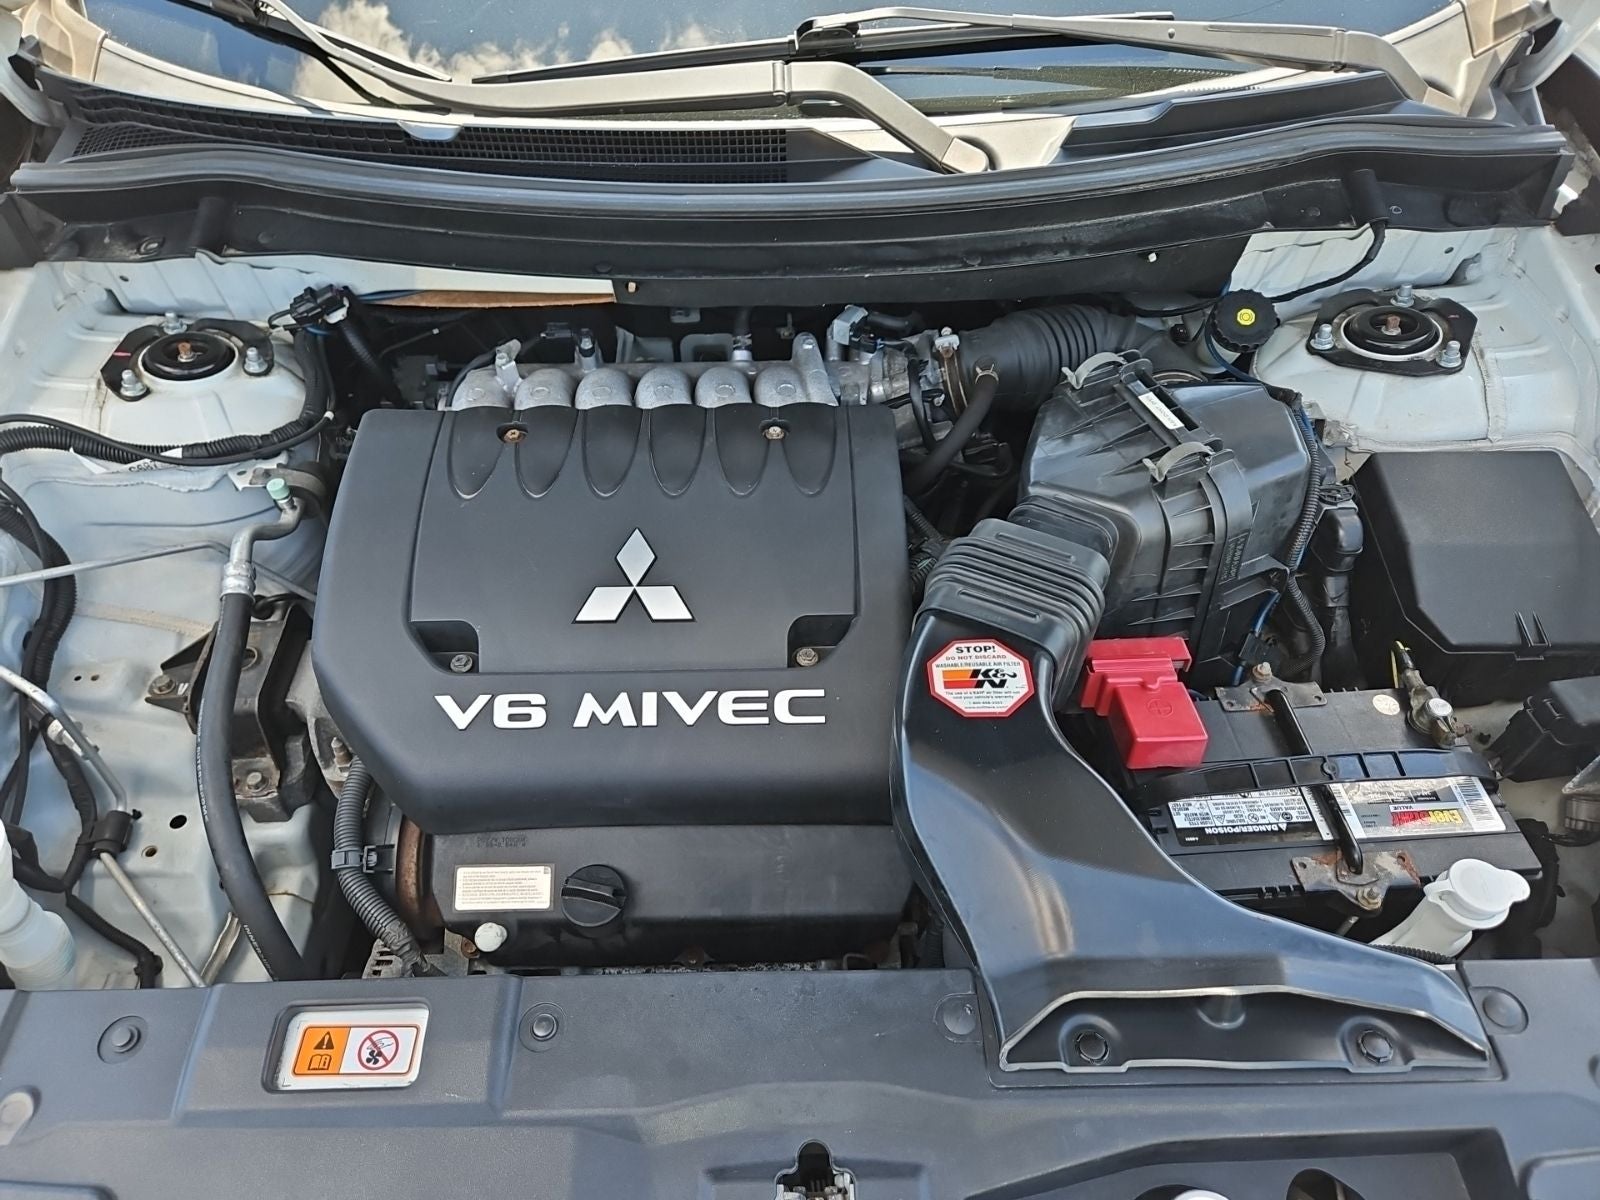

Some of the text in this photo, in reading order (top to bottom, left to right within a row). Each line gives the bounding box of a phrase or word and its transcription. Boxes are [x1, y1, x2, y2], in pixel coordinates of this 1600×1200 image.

[955, 646, 996, 654] STOP!
[434, 689, 826, 730] V6 MIVEC
[1204, 823, 1279, 835] DANGER/POISON
